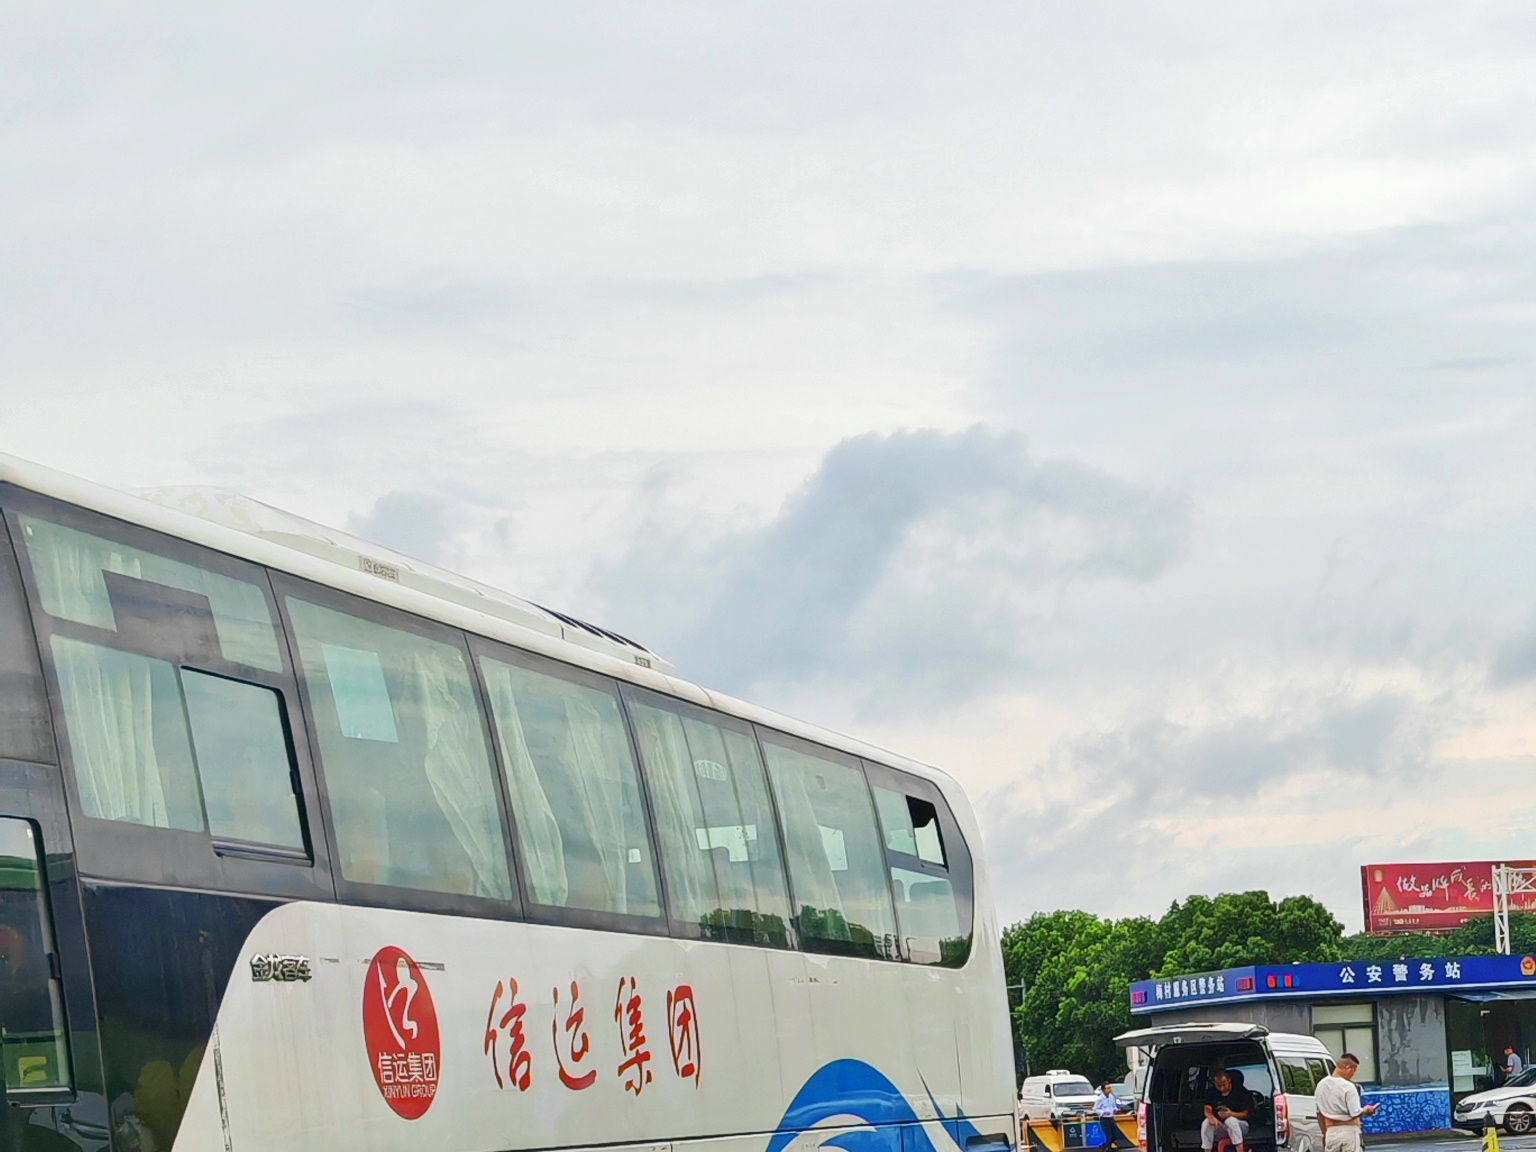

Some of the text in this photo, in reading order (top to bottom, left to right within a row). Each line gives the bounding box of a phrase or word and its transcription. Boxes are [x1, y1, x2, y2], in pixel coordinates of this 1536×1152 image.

[1340, 962, 1461, 983] 公安警务站
[484, 976, 702, 1097] 信运集团
[378, 1051, 437, 1084] 信运集团
[411, 1084, 436, 1098] GROUP
